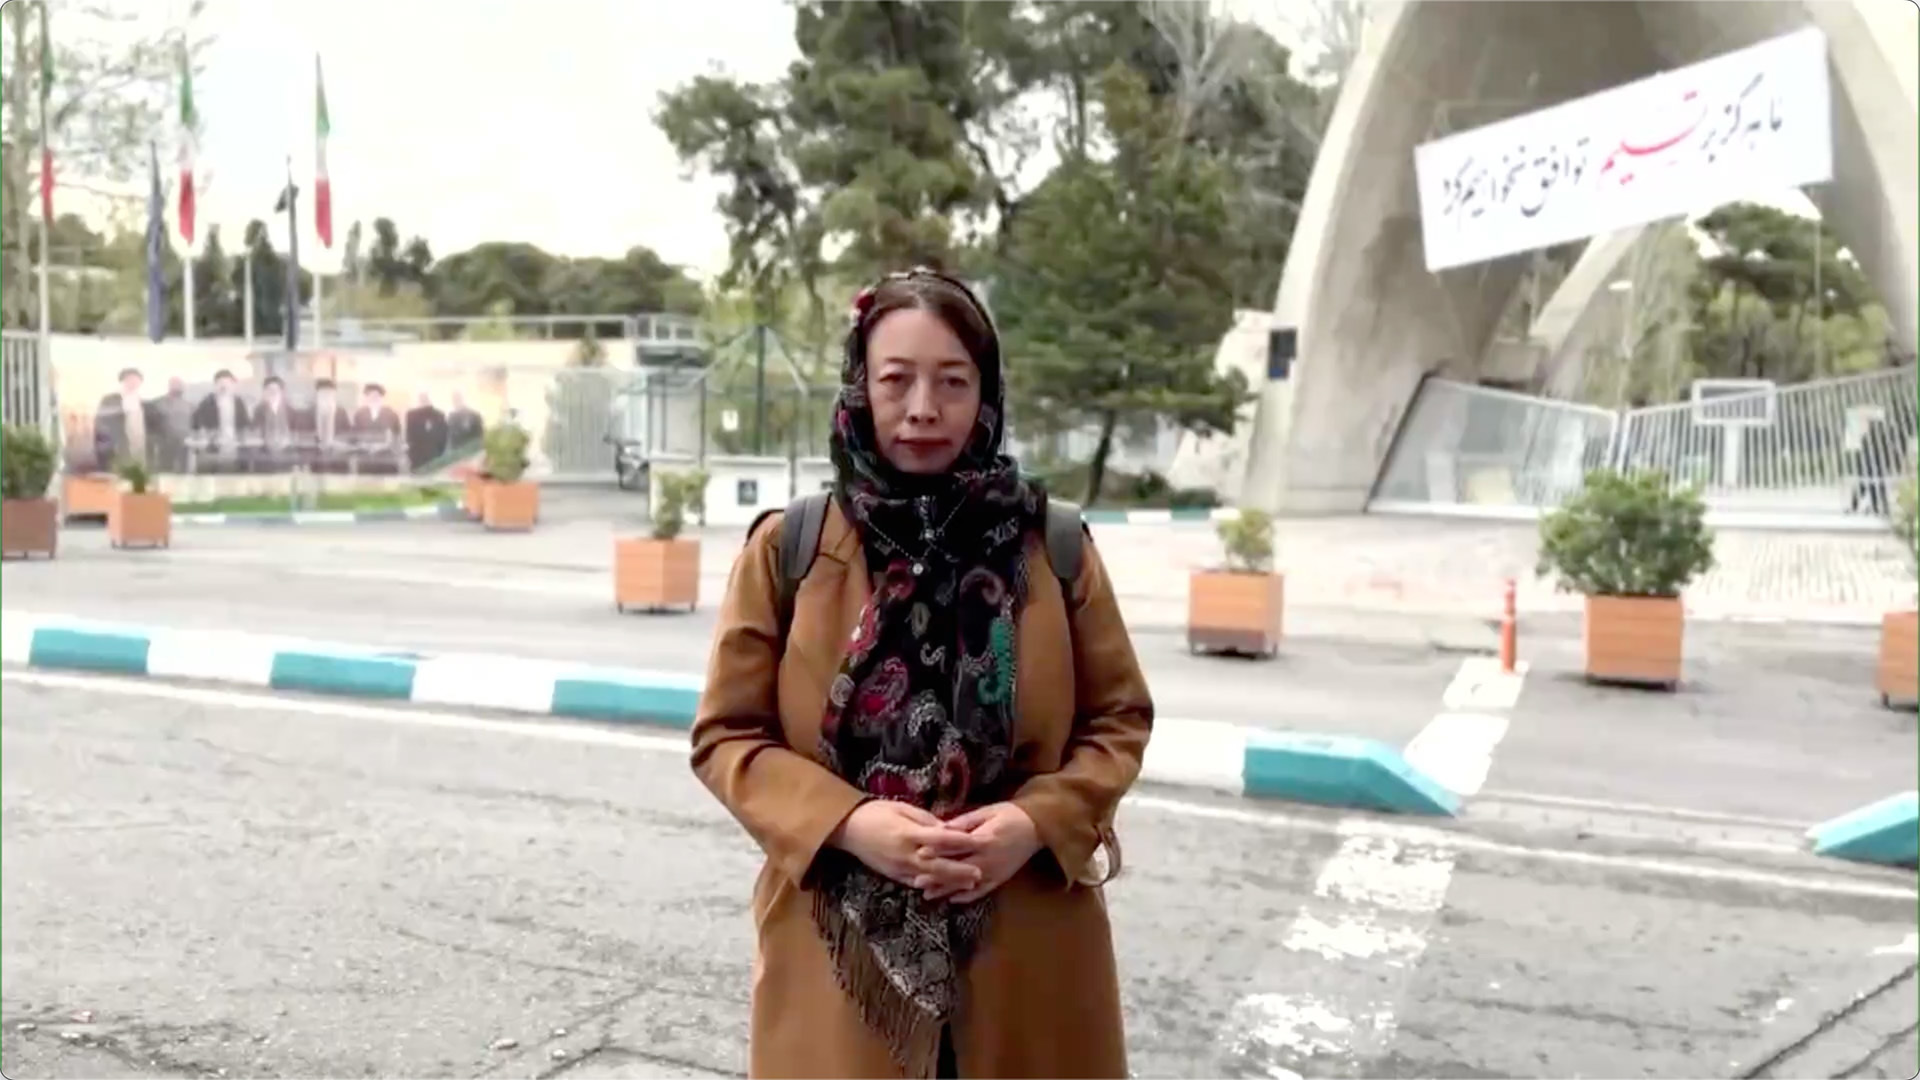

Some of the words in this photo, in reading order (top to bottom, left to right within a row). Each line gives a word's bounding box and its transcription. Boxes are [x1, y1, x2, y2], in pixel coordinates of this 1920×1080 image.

[1769, 96, 1784, 132] ما
[1699, 129, 1717, 163] بر
[1520, 138, 1590, 218] توافق
